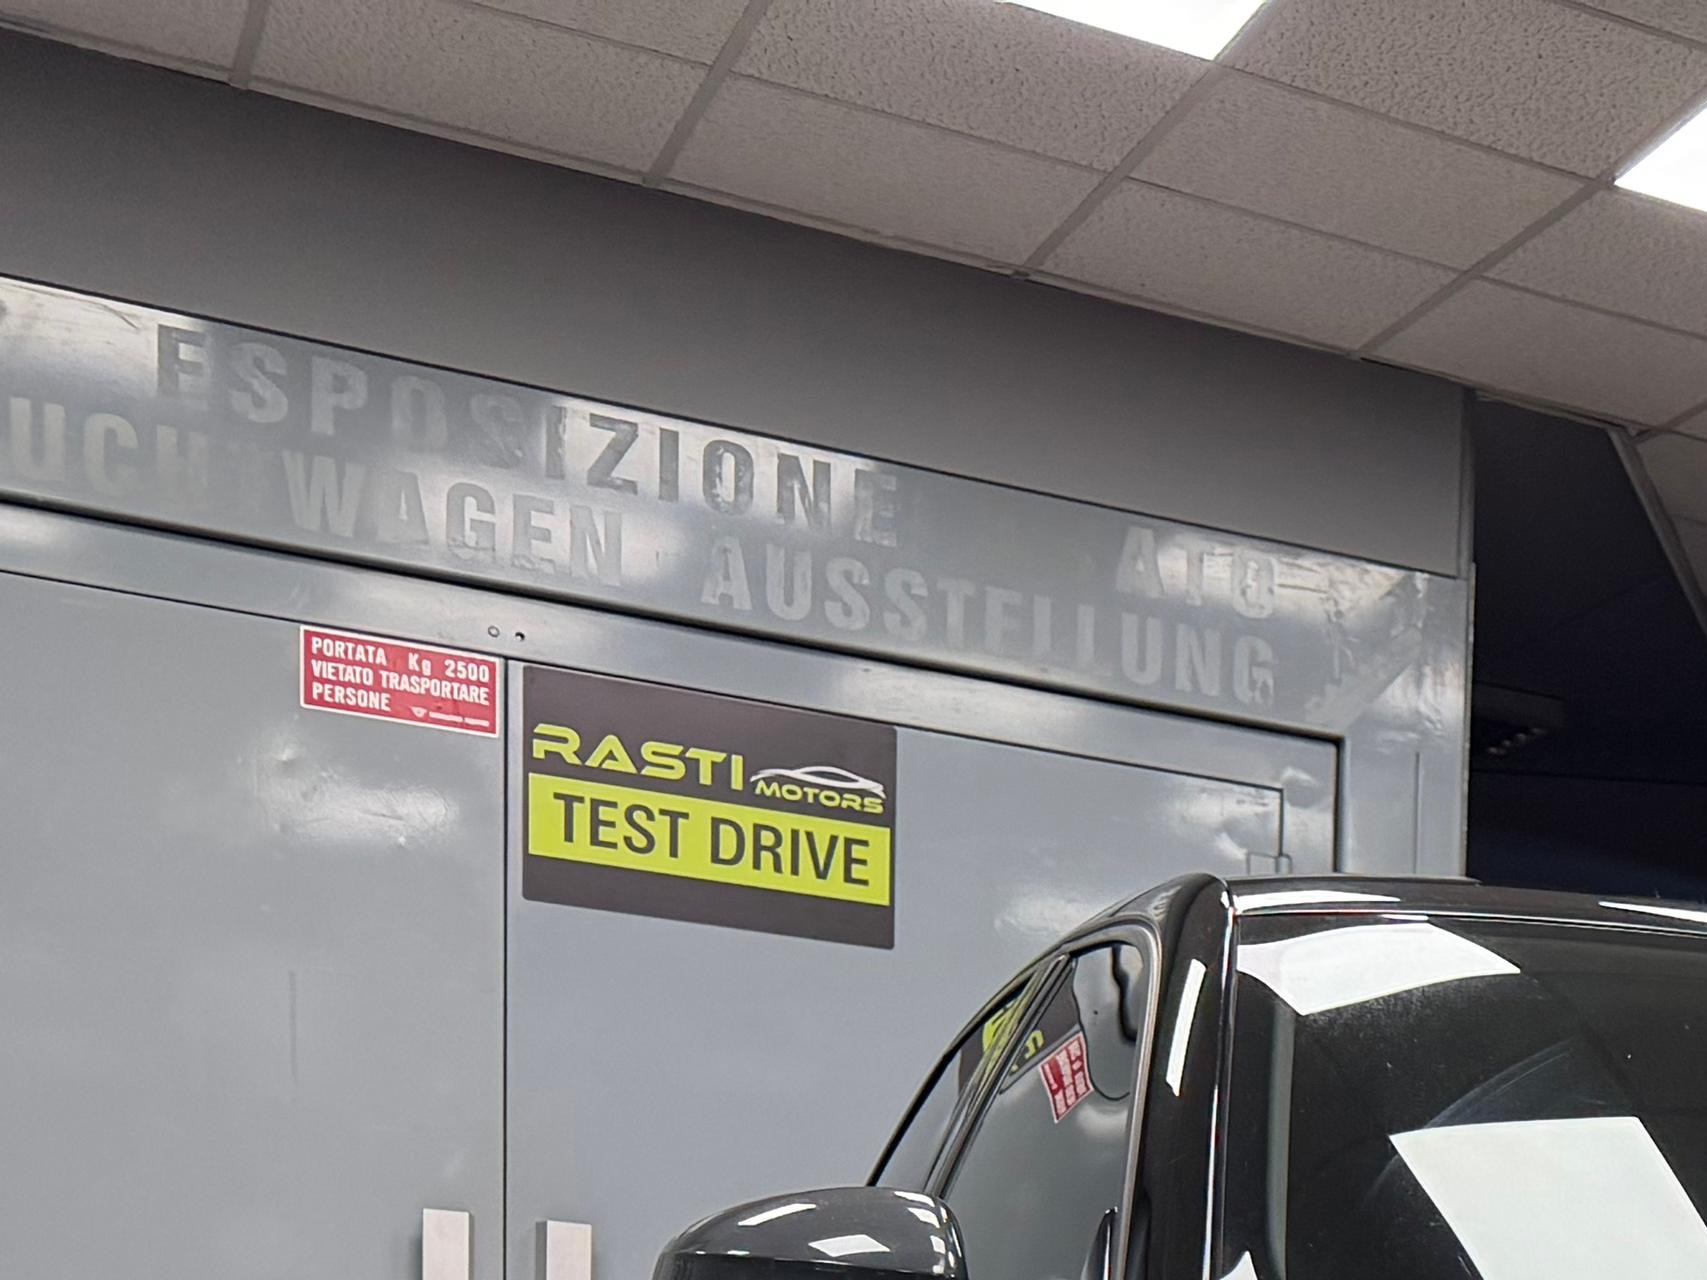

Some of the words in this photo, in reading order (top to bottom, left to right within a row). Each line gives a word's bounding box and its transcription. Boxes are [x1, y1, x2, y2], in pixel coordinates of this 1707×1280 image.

[311, 636, 388, 667] PORTATA
[408, 652, 432, 676] Kg
[444, 659, 490, 683] 2500
[311, 659, 374, 687] VIETATO
[379, 670, 490, 706] TRASPORTARE
[312, 681, 392, 712] PERSONE
[532, 722, 744, 791] RASTI
[754, 779, 885, 814] MOTORS
[552, 791, 690, 860] TEST
[710, 815, 870, 887] DRIVE
